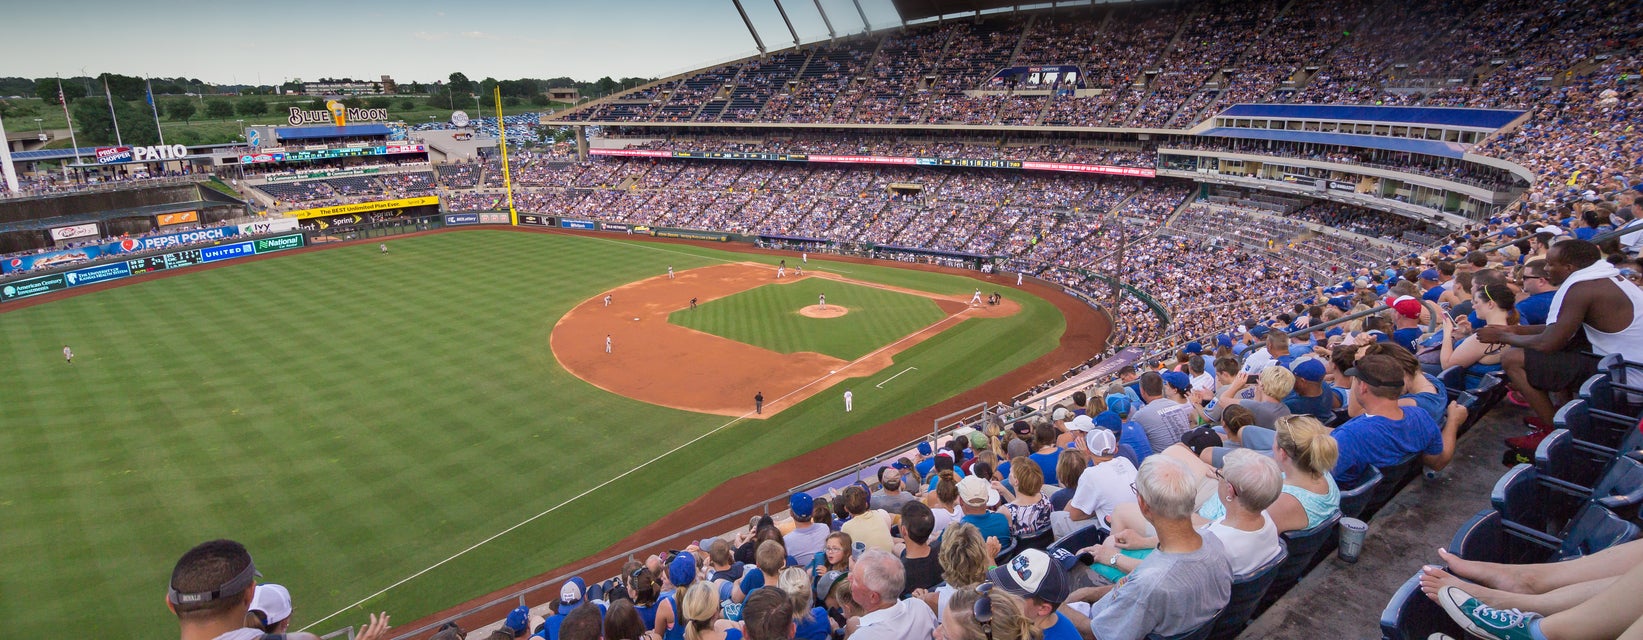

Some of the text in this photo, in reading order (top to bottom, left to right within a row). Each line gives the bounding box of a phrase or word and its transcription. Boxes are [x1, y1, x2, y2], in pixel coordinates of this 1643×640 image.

[98, 147, 118, 157] PRICE
[133, 144, 188, 161] PATIO
[99, 152, 131, 164] CHOPPER
[346, 204, 375, 212] Unlimited
[333, 216, 353, 226] Sprint
[254, 223, 271, 231] Ivy
[145, 229, 224, 248] PEPSI PORCH
[268, 236, 298, 247] National
[205, 247, 241, 258] UNITED
[17, 278, 63, 291] American Century
[17, 286, 49, 295] Investments
